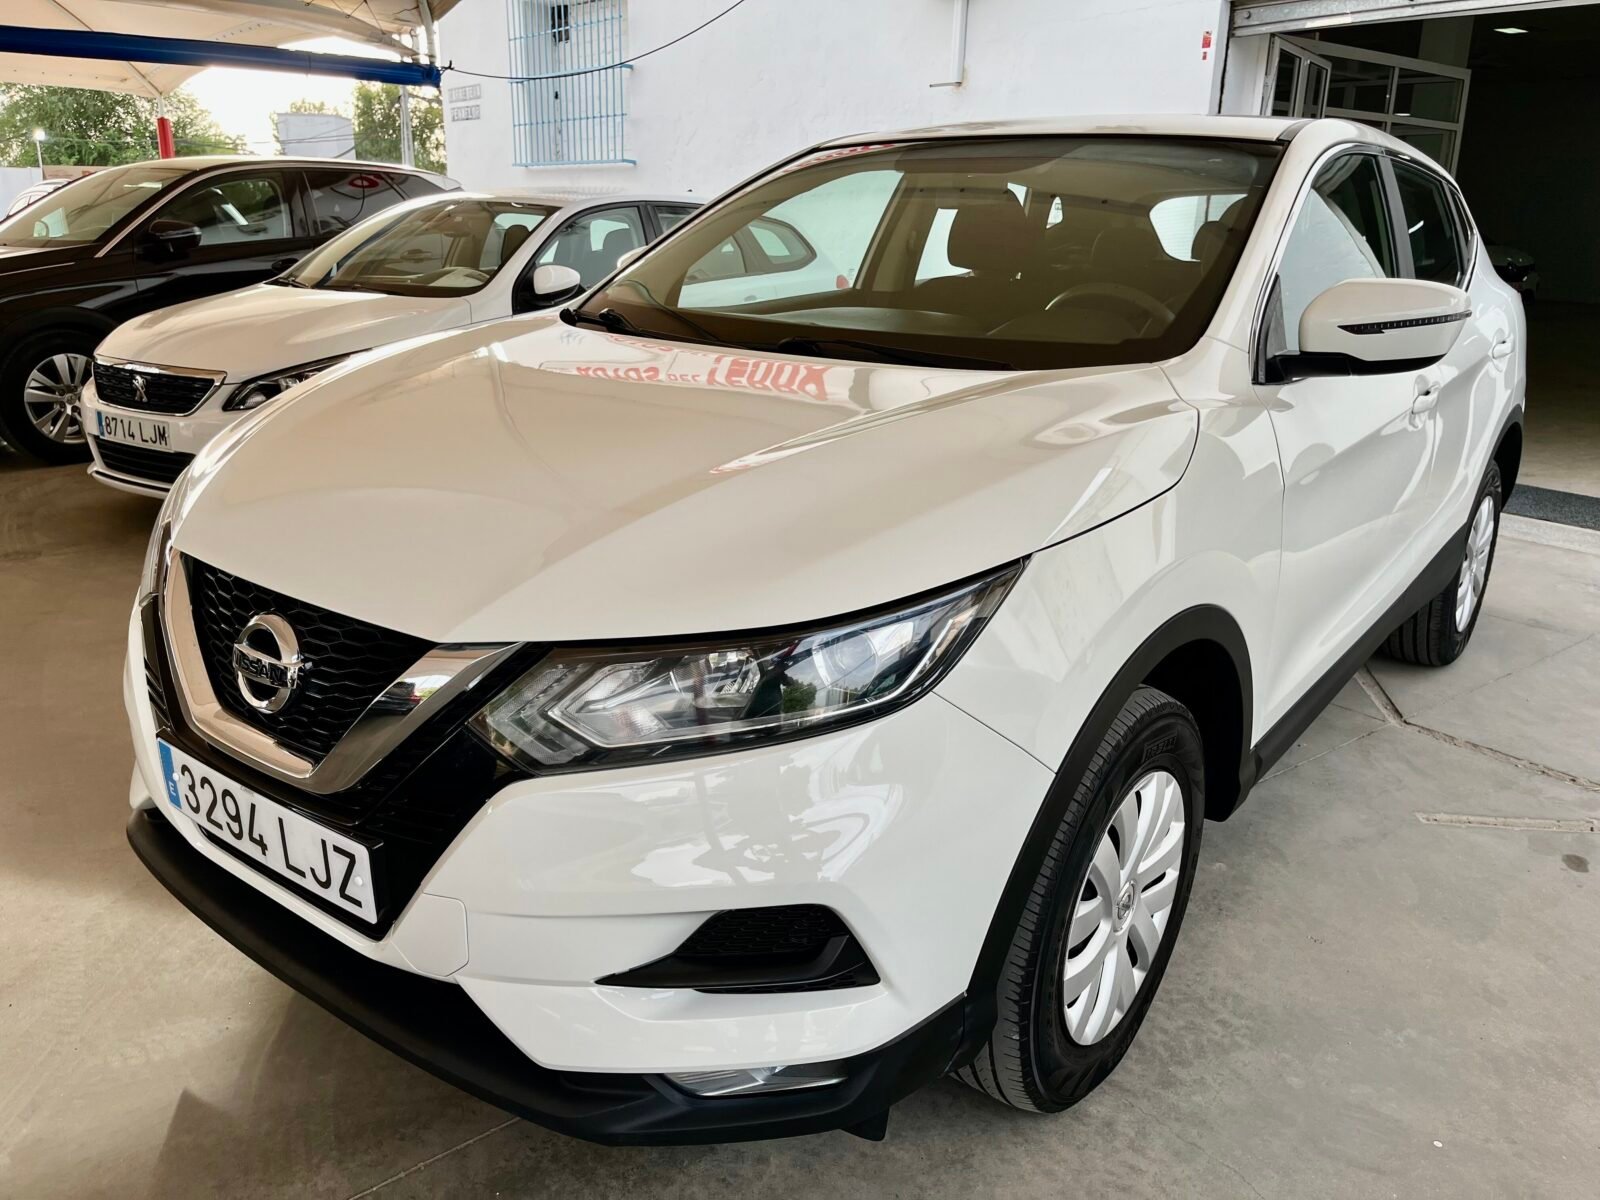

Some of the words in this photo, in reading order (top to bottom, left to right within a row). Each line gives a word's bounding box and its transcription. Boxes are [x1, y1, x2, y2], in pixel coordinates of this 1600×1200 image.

[104, 415, 136, 441] 8714
[138, 421, 168, 446] LJM
[168, 782, 176, 796] E
[180, 763, 268, 857] 3294
[277, 816, 363, 909] LJZ
